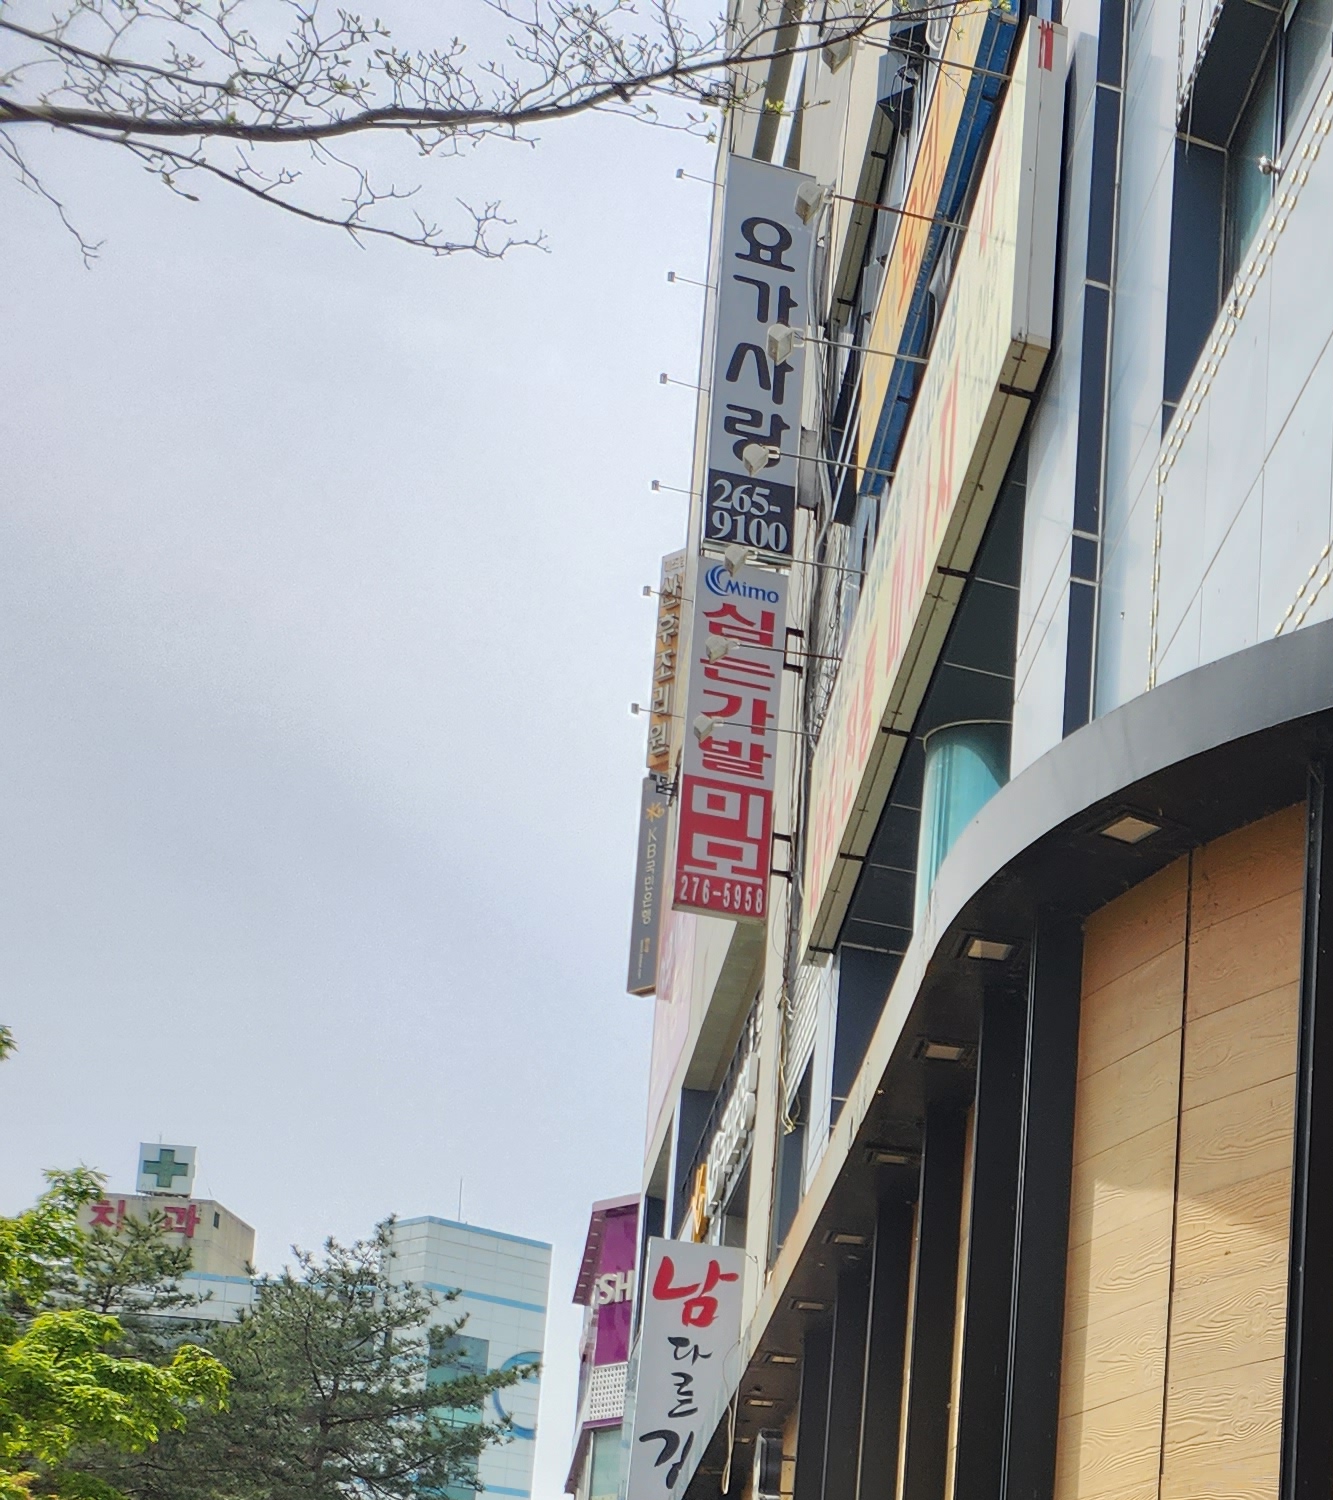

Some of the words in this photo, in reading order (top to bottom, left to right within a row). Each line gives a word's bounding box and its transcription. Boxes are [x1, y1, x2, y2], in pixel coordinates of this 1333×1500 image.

[724, 216, 799, 469] 요가사랑
[712, 479, 781, 517] 265-
[712, 511, 788, 553] 9100
[725, 579, 780, 605] Mimo
[648, 573, 683, 758] 산후조리원
[682, 783, 767, 886] 미모
[680, 874, 765, 915] 276-5958
